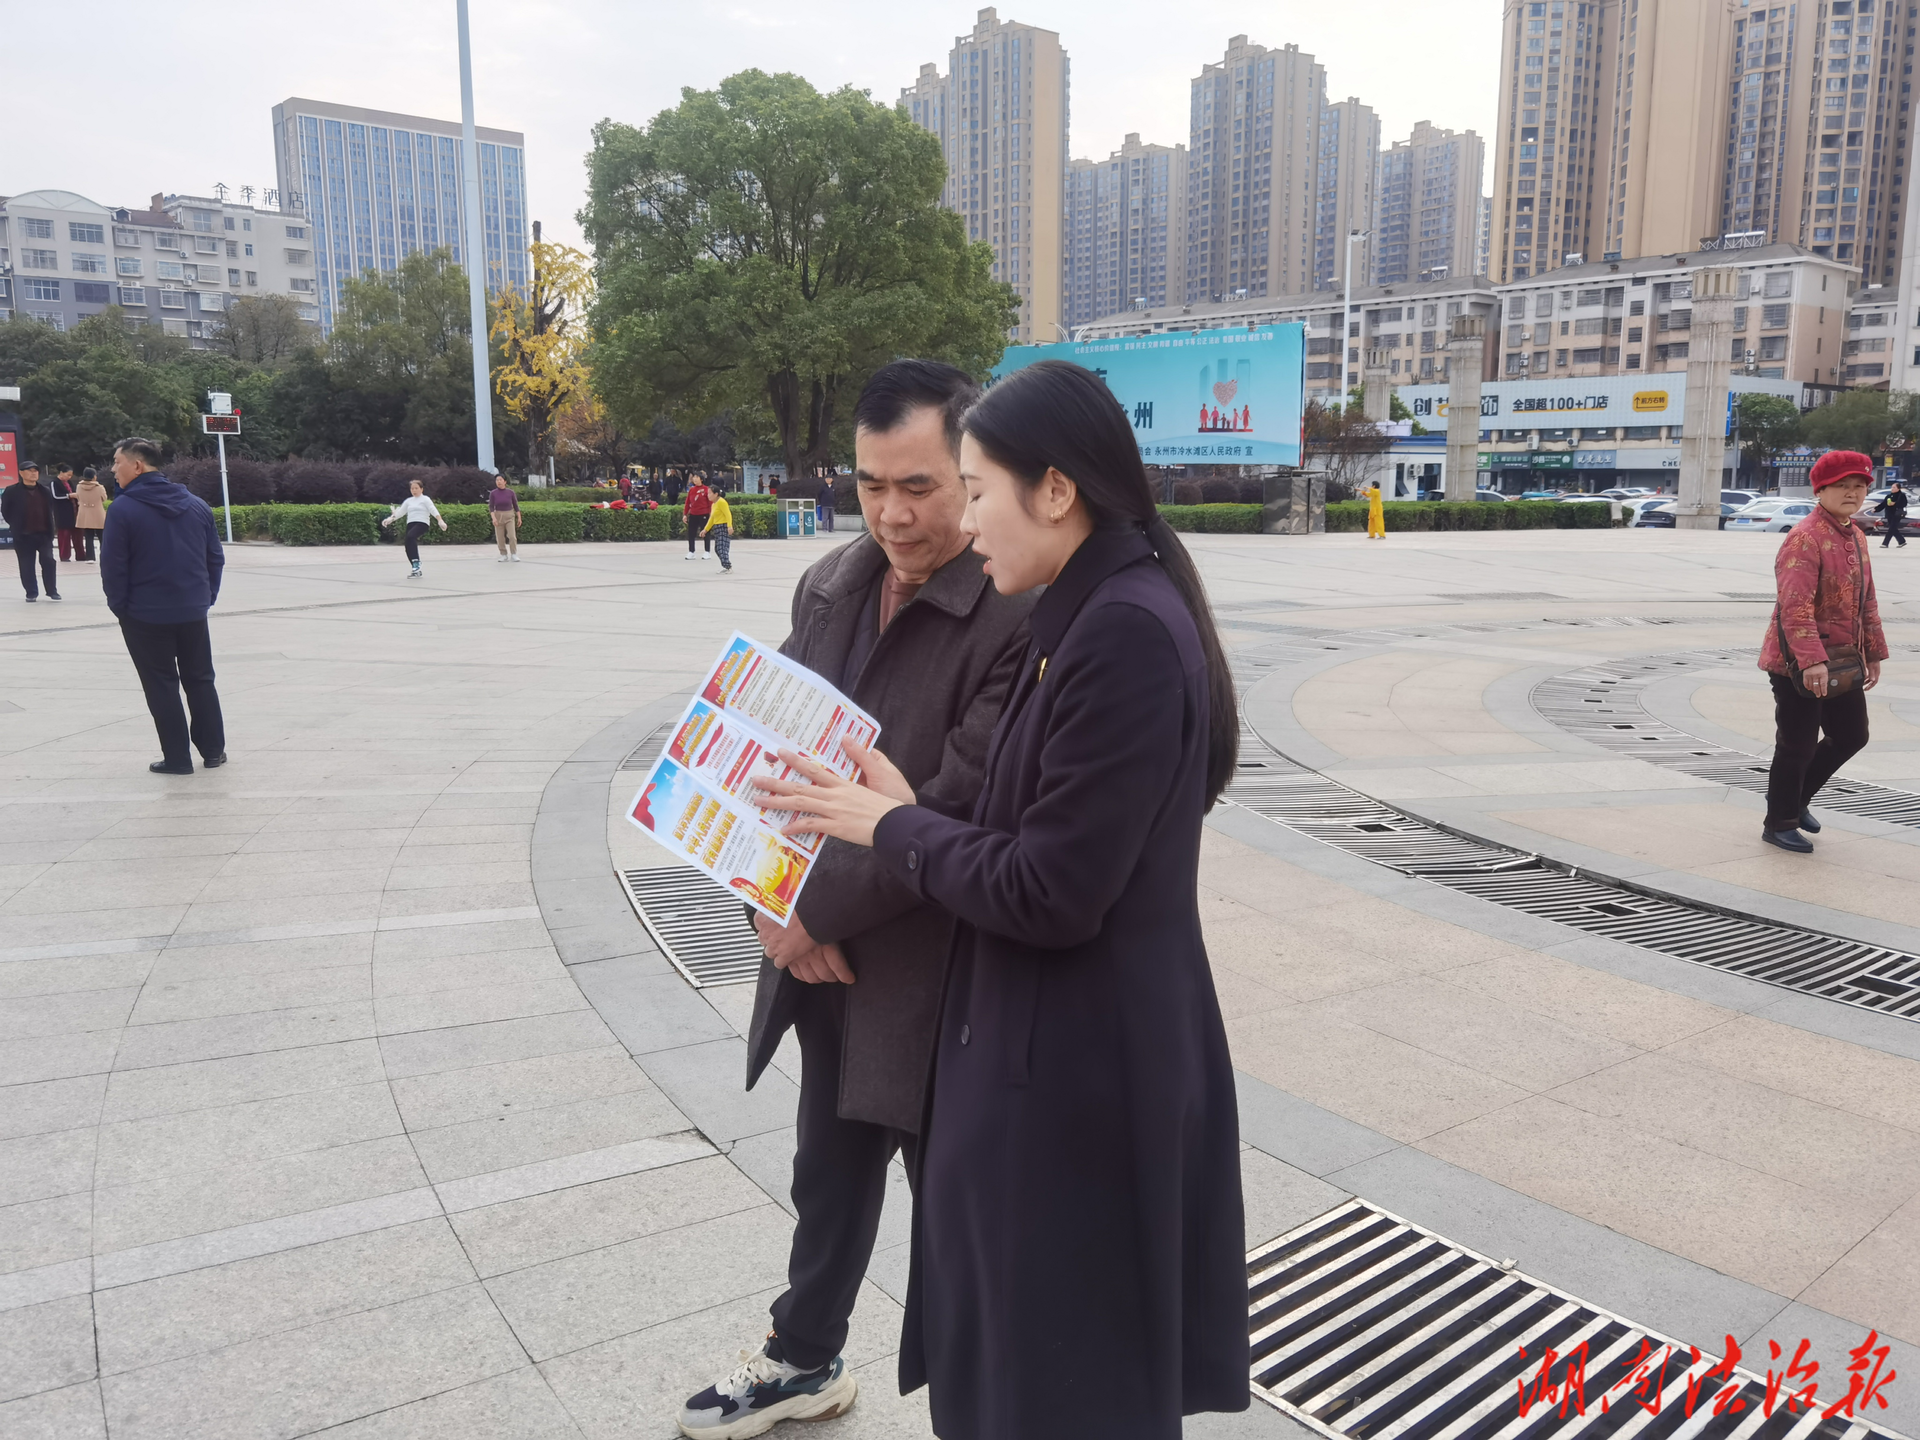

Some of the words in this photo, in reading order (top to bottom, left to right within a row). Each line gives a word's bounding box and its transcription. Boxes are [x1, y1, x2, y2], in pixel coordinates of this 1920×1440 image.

[1512, 395, 1609, 411] 全国超100+门店
[1155, 446, 1242, 457] 永州市冷水滩区人民政府
[1245, 446, 1253, 456] 宣
[683, 795, 722, 855] 中华人民共和国
